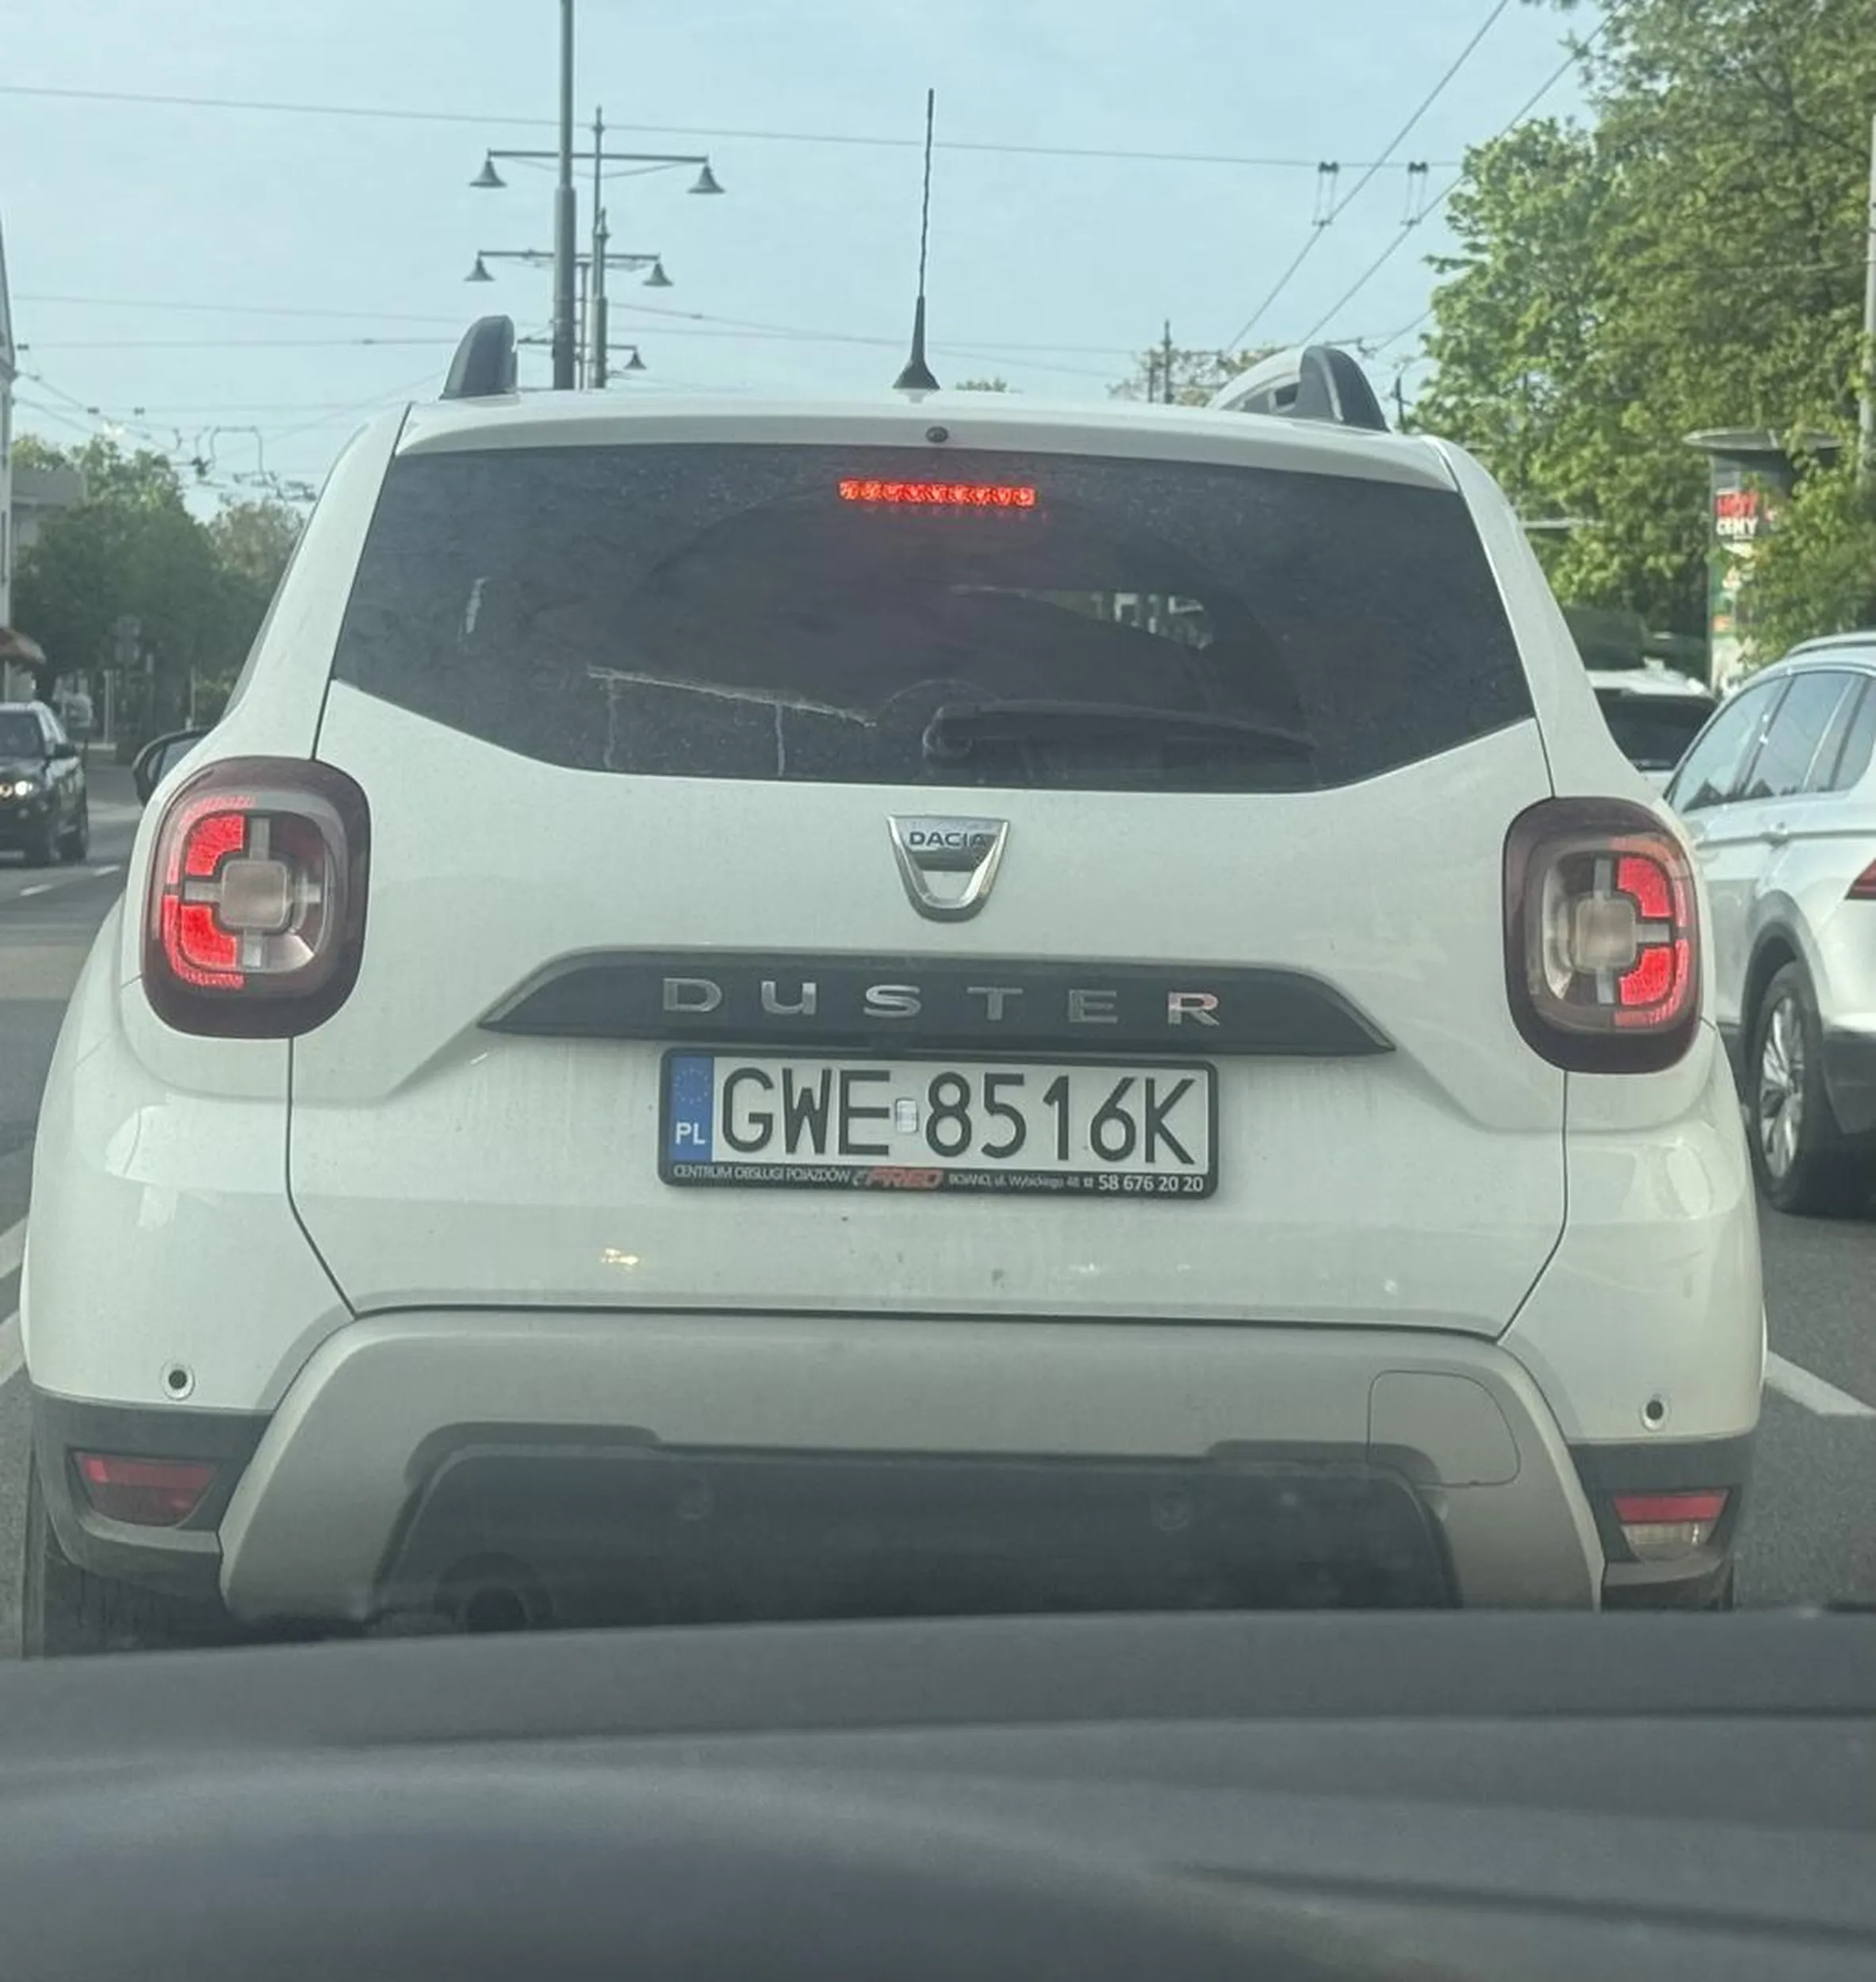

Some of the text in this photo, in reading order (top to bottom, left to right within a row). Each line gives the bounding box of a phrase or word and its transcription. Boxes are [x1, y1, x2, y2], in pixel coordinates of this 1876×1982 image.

[909, 832, 986, 847] DACIA
[662, 977, 1220, 1026] DUSTER
[722, 1067, 1196, 1165] GWE 8516K
[675, 1122, 706, 1146] PL
[674, 1165, 732, 1179] CENTRUM
[1098, 1173, 1120, 1191] 58
[1123, 1174, 1154, 1192] 676
[1158, 1175, 1179, 1192] 20
[1182, 1176, 1204, 1192] 20
